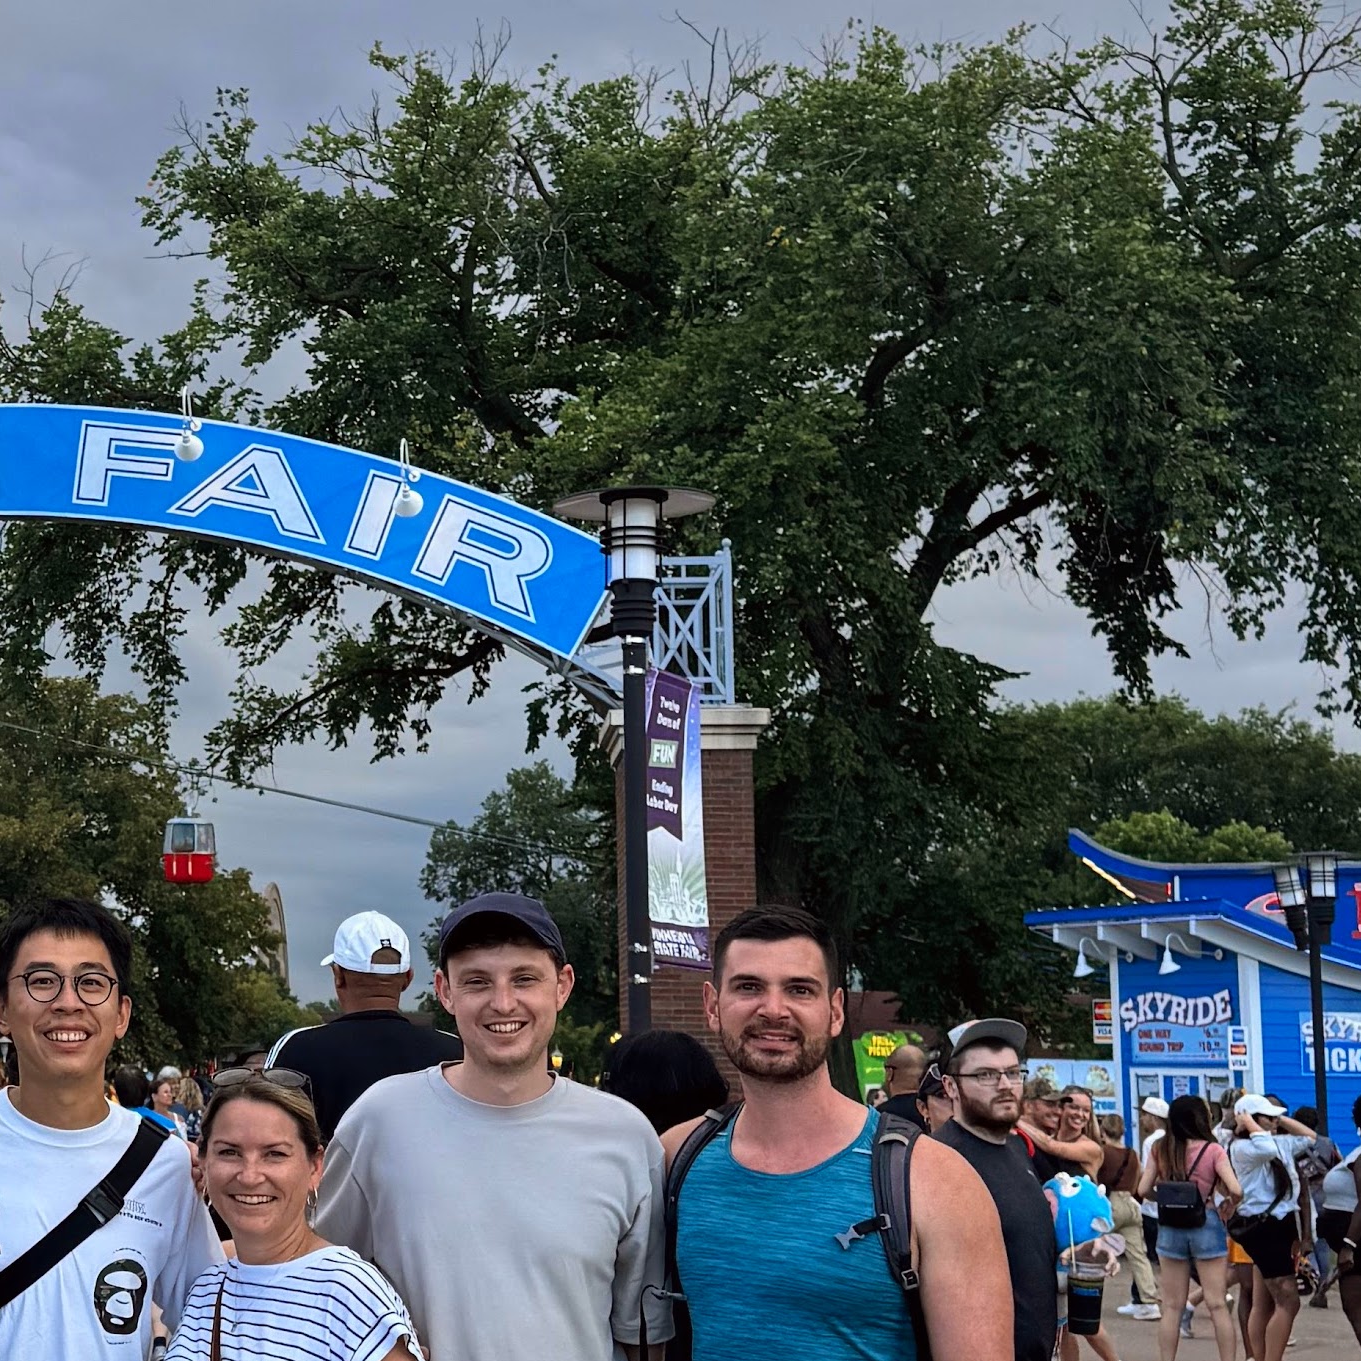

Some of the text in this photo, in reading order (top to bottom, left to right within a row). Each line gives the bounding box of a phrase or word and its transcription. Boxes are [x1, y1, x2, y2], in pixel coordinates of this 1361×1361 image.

[72, 419, 553, 624] FAIR
[652, 743, 676, 764] FUN
[651, 778, 674, 798] Ending
[646, 793, 679, 815] Labor Day
[653, 940, 680, 957] STATE
[1120, 989, 1232, 1032] SKYRIDE
[1138, 1029, 1153, 1039] ONE
[1155, 1029, 1172, 1039] WAY
[1138, 1041, 1165, 1053] ROUND
[1167, 1041, 1185, 1053] TRIP
[1231, 1059, 1247, 1067] VISA
